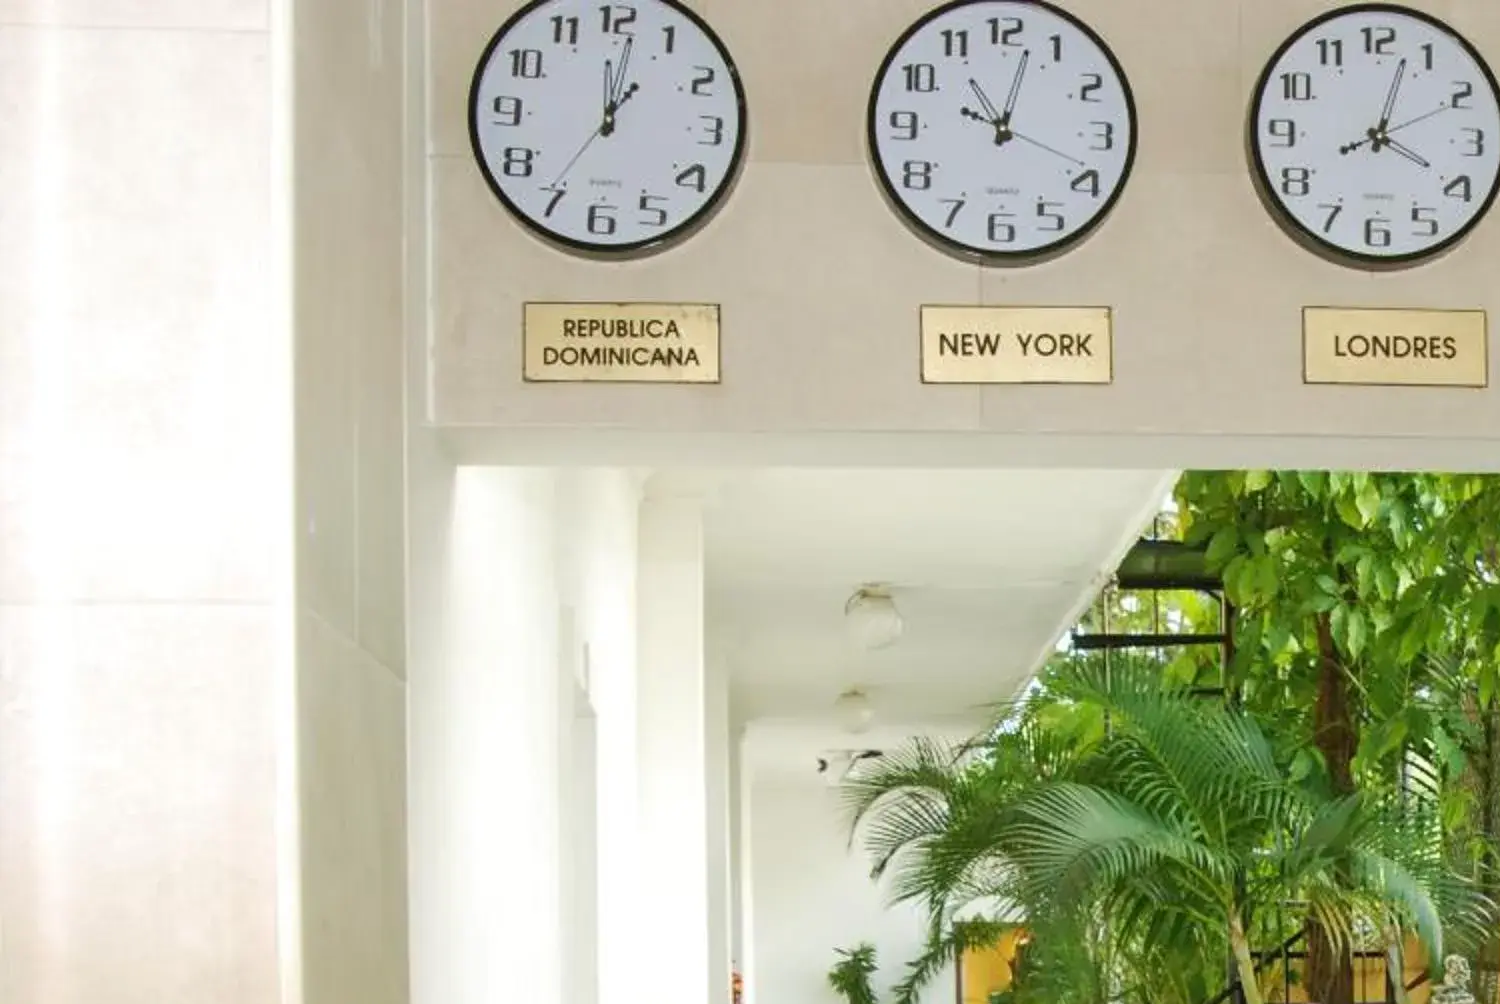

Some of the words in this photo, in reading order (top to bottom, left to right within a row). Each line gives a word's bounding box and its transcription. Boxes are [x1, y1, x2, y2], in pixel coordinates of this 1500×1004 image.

[551, 16, 579, 44] 11
[599, 5, 636, 35] 12
[986, 18, 1024, 46] 12
[662, 26, 675, 53] 1
[941, 30, 968, 57] 11
[1050, 35, 1061, 62] 1
[1316, 39, 1343, 66] 11
[1361, 27, 1395, 55] 12
[509, 49, 542, 78] 10
[1422, 44, 1433, 70] 1
[692, 66, 714, 96] 2
[903, 64, 935, 92] 10
[1080, 74, 1102, 102] 2
[1280, 72, 1311, 100] 10
[1451, 81, 1472, 109] 2
[493, 96, 523, 126] 9
[697, 115, 723, 145] 3
[890, 112, 918, 140] 9
[1089, 121, 1113, 151] 3
[1269, 119, 1294, 147] 9
[1461, 128, 1483, 156] 3
[503, 147, 533, 177] 8
[903, 160, 932, 190] 8
[675, 164, 705, 193] 4
[1070, 170, 1101, 198] 4
[1282, 168, 1309, 195] 8
[1443, 175, 1471, 201] 4
[538, 187, 566, 217] 7
[638, 195, 669, 226] 5
[939, 199, 965, 228] 7
[587, 205, 618, 235] 6
[987, 214, 1016, 242] 6
[1037, 202, 1065, 231] 5
[1318, 203, 1342, 232] 7
[1411, 207, 1438, 236] 5
[1365, 218, 1391, 246] 6
[562, 318, 680, 340] REPUBLICA
[542, 345, 700, 368] DOMINICANA
[938, 332, 1001, 357] NEW
[1016, 332, 1093, 358] YORK
[1334, 334, 1457, 360] LONDRES
